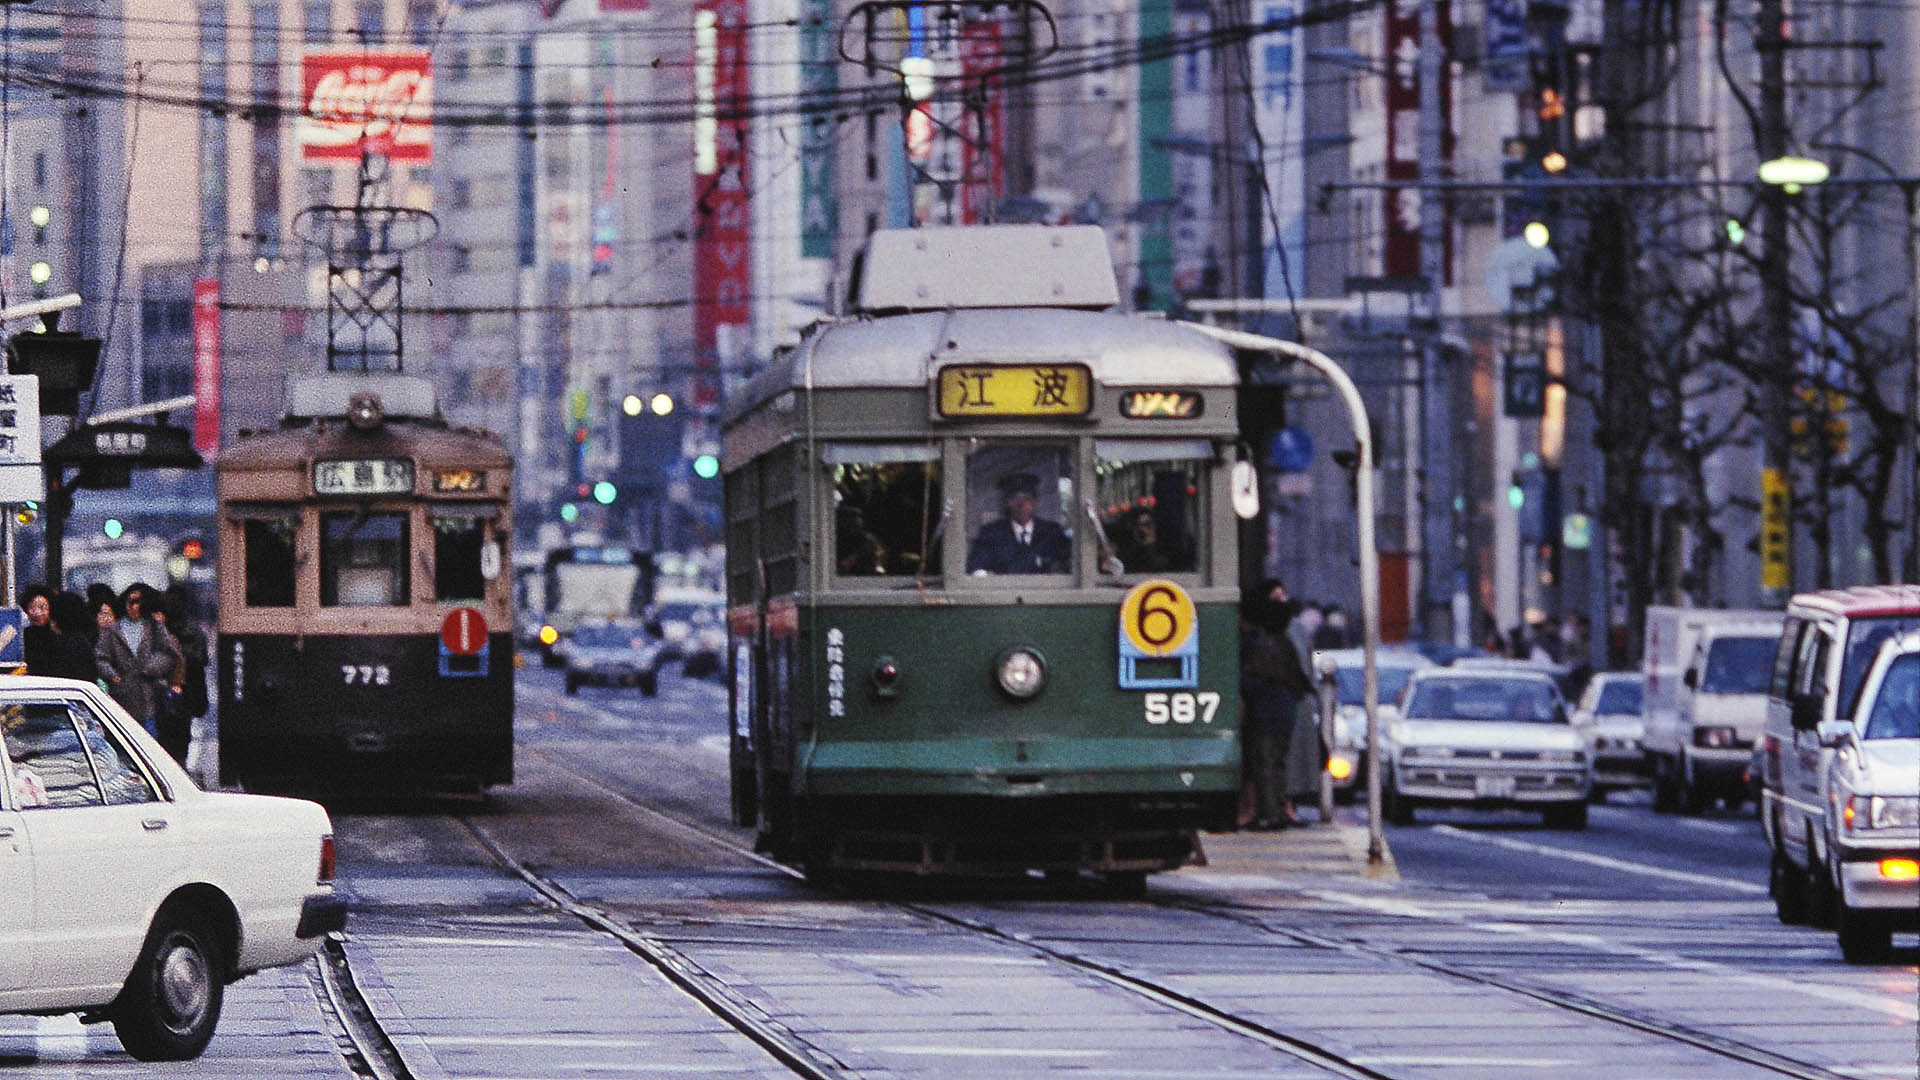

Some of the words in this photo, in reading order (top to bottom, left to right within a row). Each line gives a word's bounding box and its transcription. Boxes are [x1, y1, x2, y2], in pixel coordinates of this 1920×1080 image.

[957, 369, 1068, 407] 江波
[1138, 586, 1177, 645] 6
[341, 664, 390, 685] 772
[1145, 692, 1221, 724] 587
